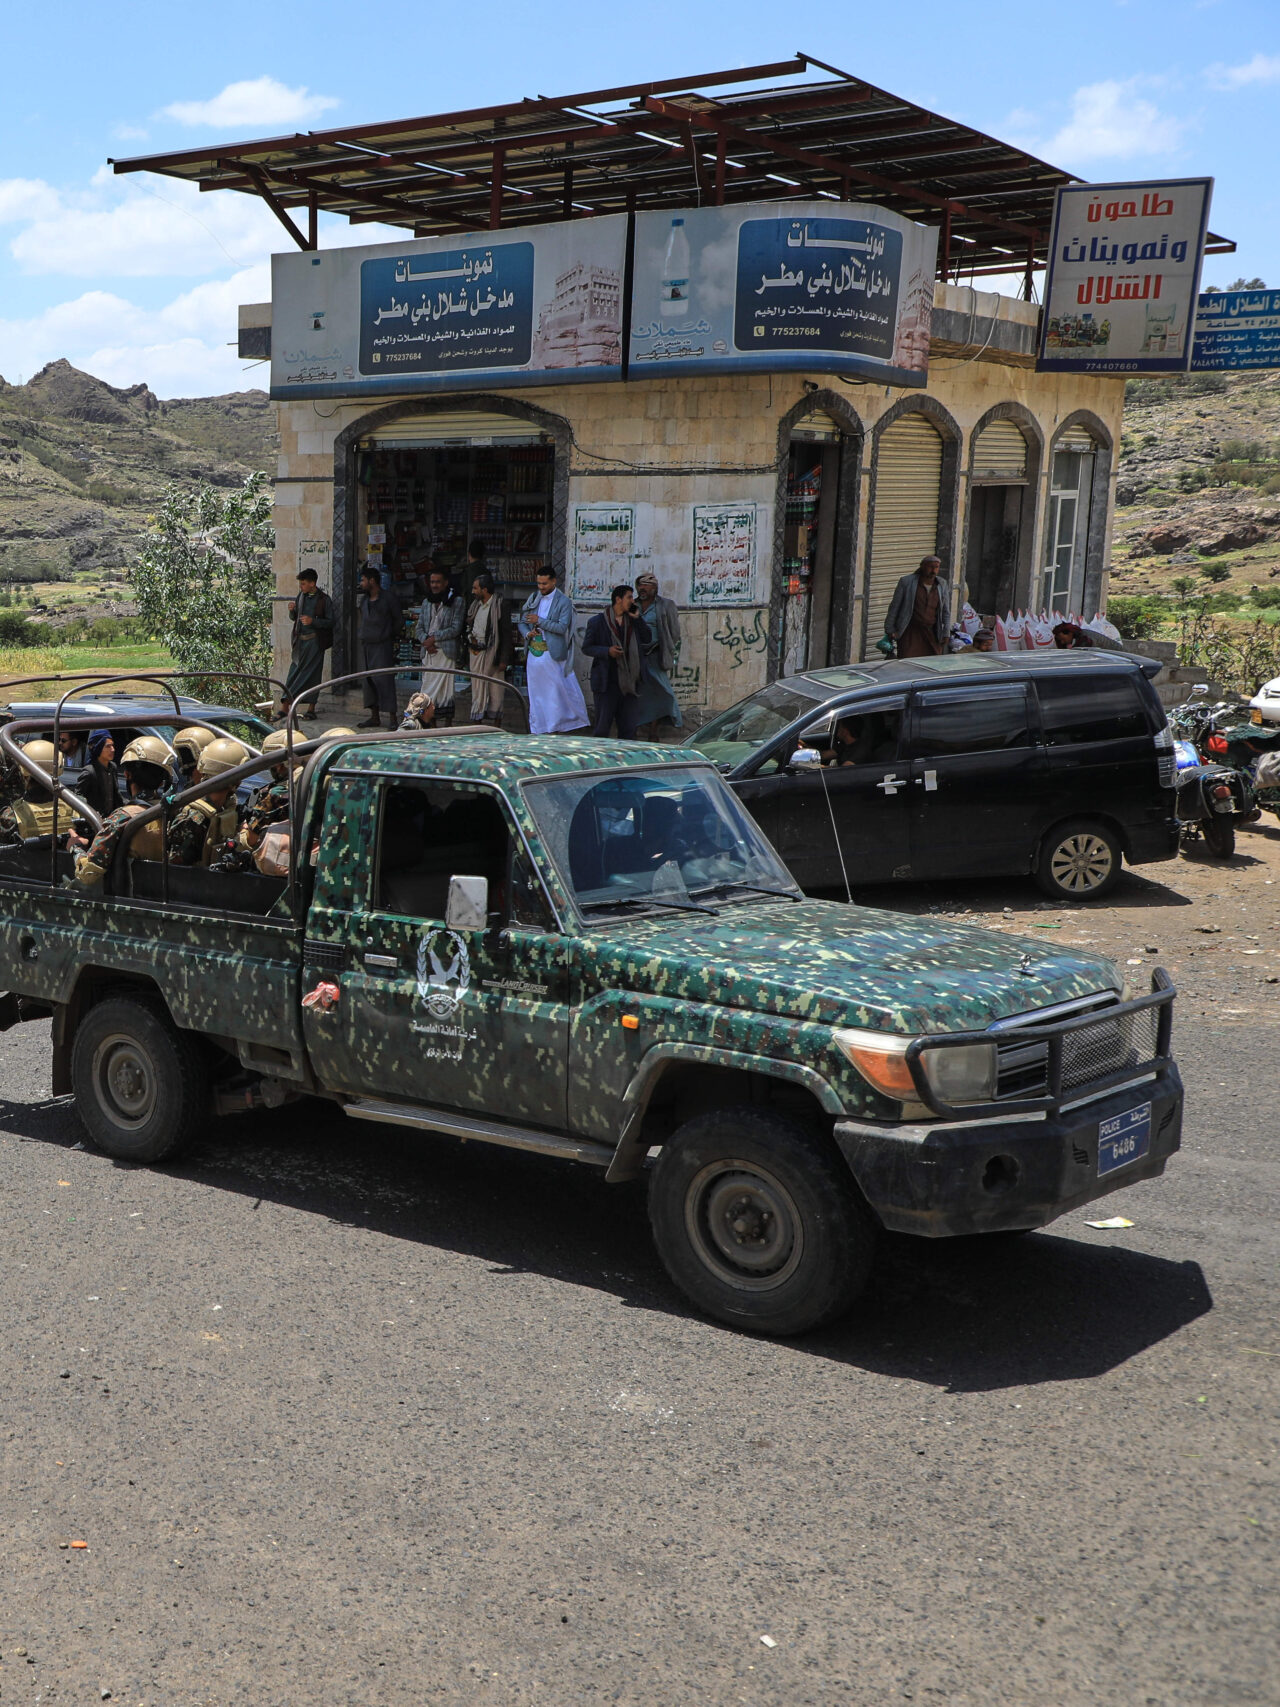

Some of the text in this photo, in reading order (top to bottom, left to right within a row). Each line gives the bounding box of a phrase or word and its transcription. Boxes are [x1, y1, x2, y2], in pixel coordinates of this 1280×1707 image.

[1088, 193, 1173, 222] طاحون
[787, 222, 885, 260] تموينات
[1063, 234, 1188, 265] وتموينات
[395, 251, 493, 283] تموينات
[755, 262, 891, 298] مدخل شلال بني مطر
[1077, 274, 1162, 304] الشلال
[373, 286, 514, 326] مدخل شلال بني مطر
[754, 306, 786, 318] والخيم
[832, 306, 859, 320] والشيش
[1230, 296, 1270, 316] الشلال
[493, 325, 515, 335] للمواد
[772, 328, 820, 336] 775237684
[1207, 320, 1241, 328] ساعة
[373, 336, 397, 346] والخيم
[432, 330, 459, 342] والشيش
[460, 327, 491, 339] الغذائية
[385, 353, 422, 362] 775237684
[1101, 1120, 1120, 1136] POLICE
[1113, 1135, 1135, 1159] 6486
